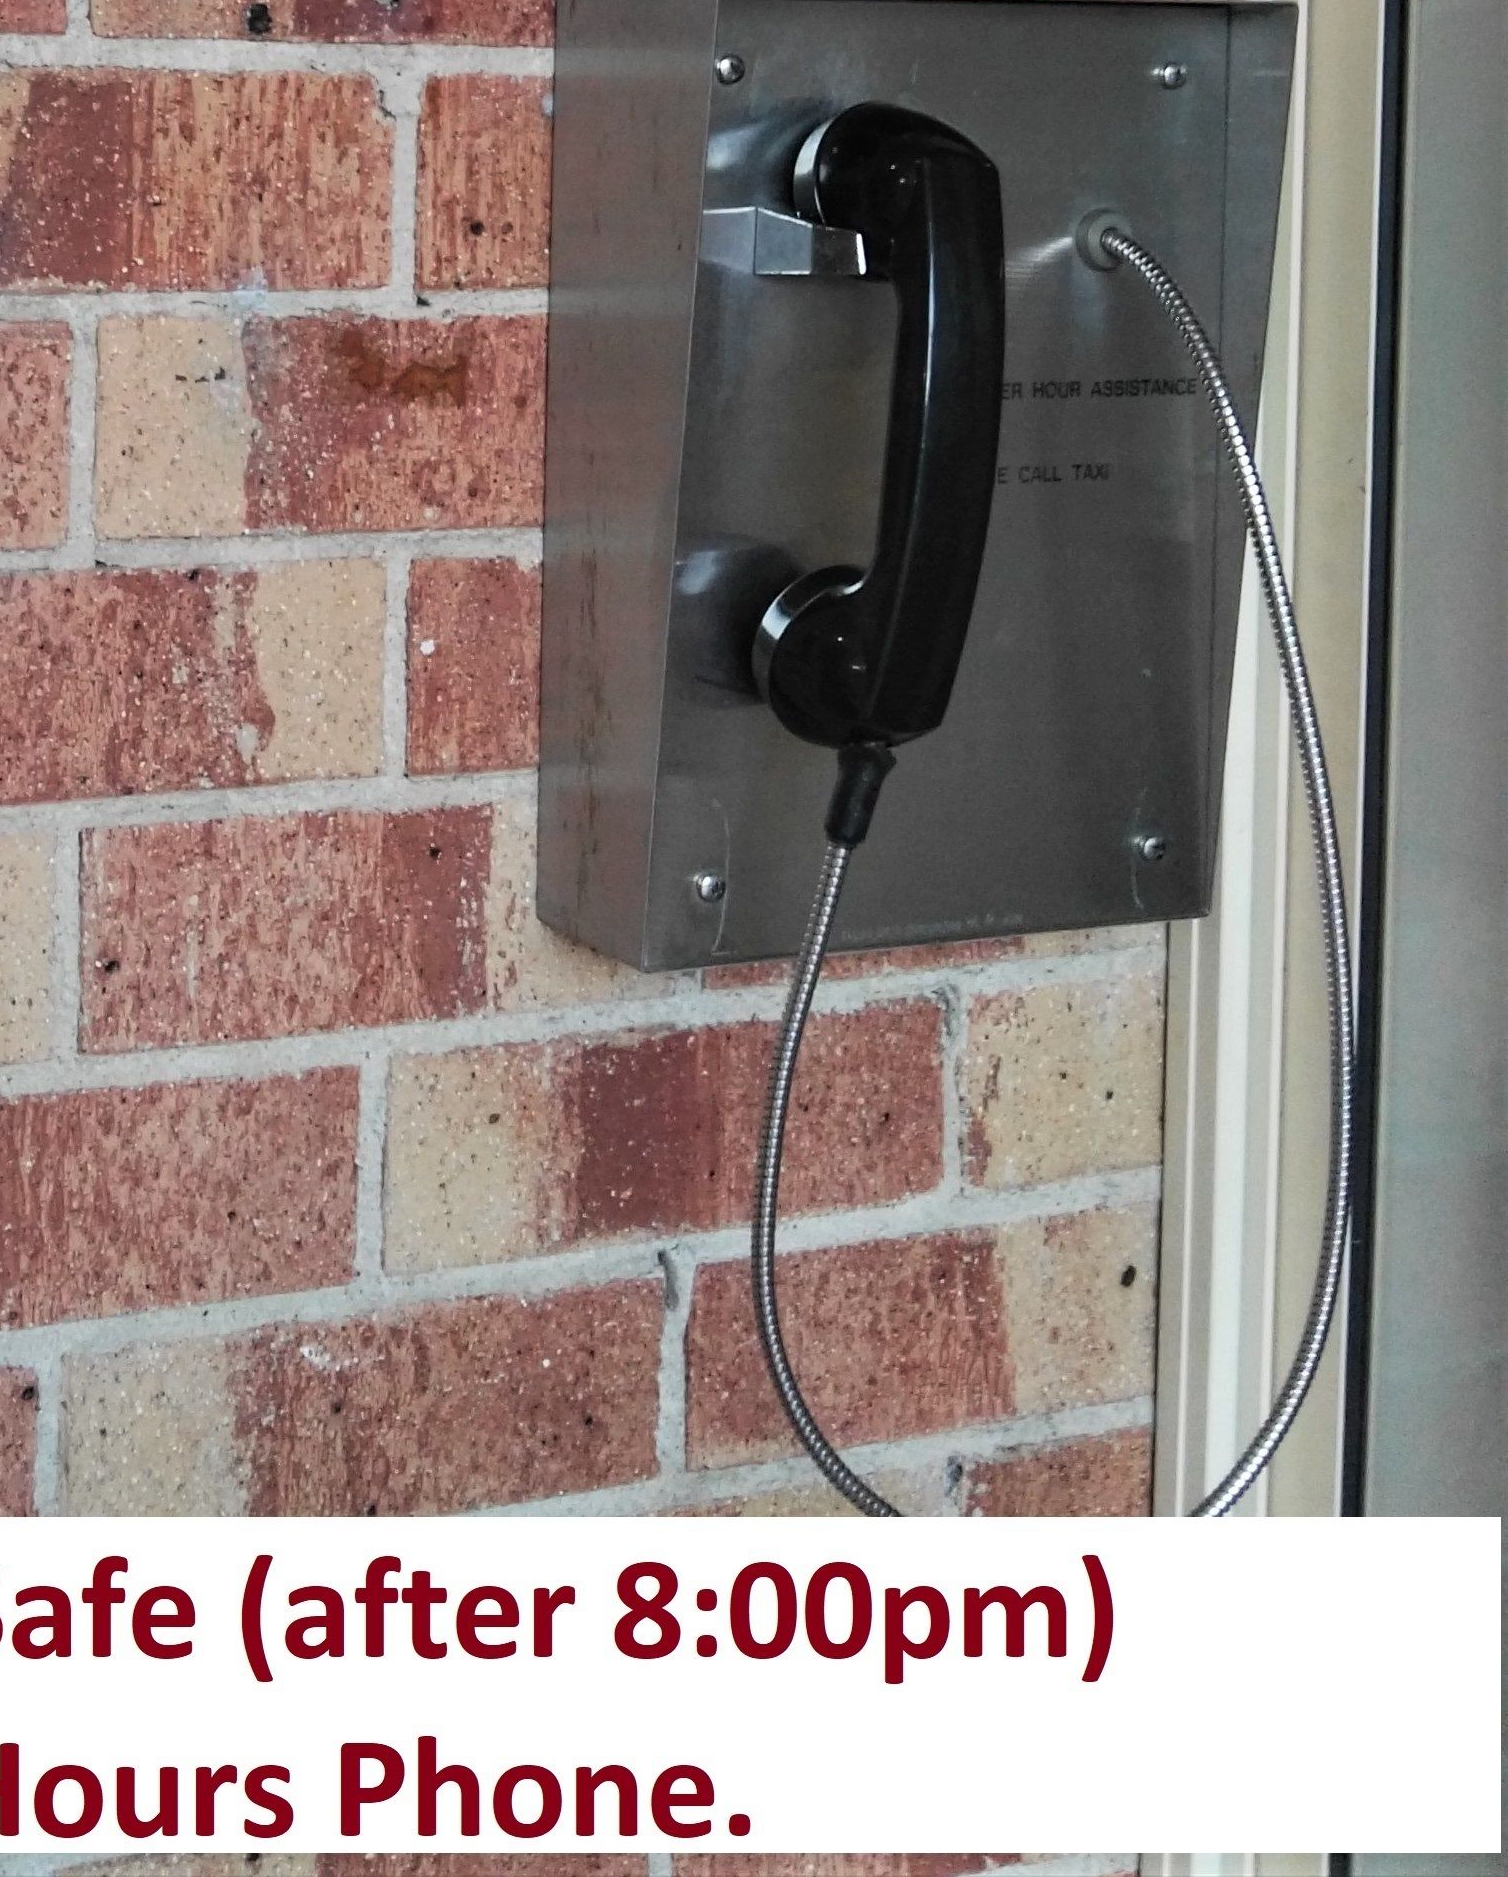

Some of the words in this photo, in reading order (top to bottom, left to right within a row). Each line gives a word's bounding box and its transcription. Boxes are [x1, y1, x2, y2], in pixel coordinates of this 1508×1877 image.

[1032, 381, 1081, 399] HOUR
[1091, 378, 1197, 397] ASSISTANCE
[1018, 466, 1062, 483] CALL
